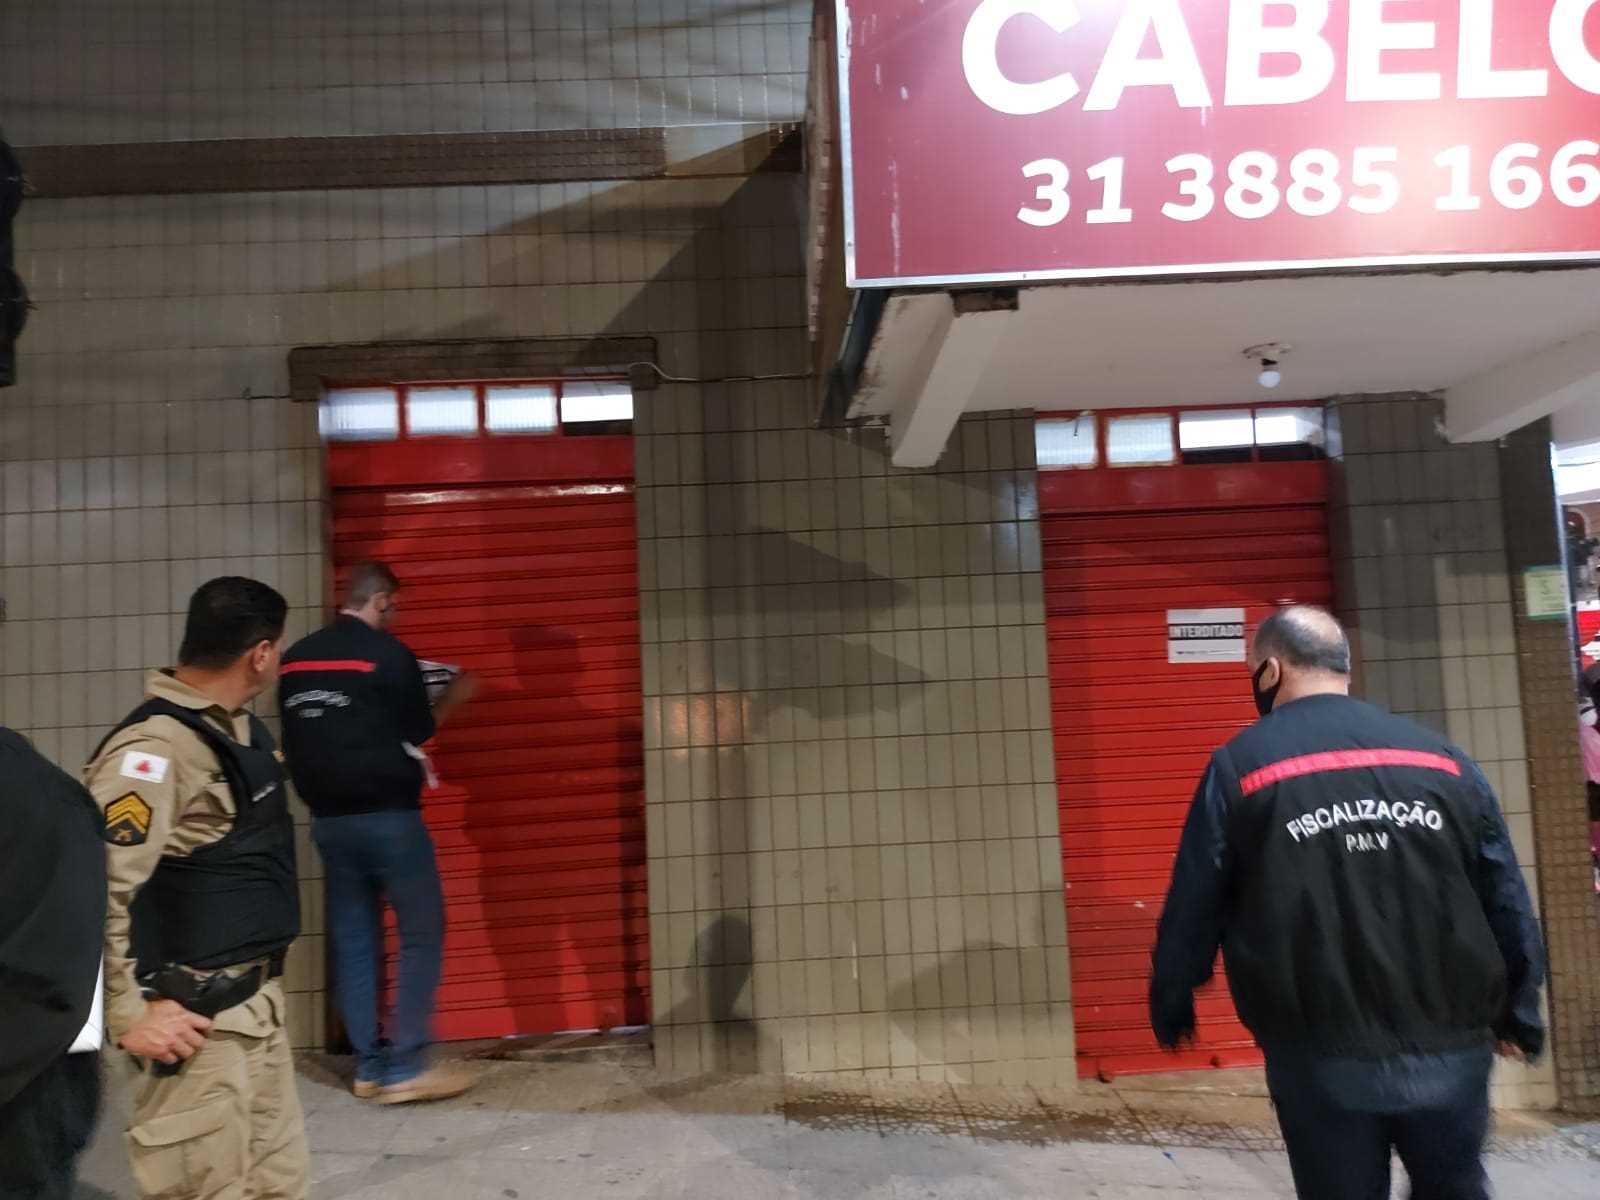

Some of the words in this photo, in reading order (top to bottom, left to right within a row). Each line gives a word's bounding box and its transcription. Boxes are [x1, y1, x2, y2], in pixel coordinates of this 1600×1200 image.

[1017, 156, 1133, 227] 31
[1162, 147, 1400, 221] 3885
[1433, 140, 1600, 211] 166
[1286, 799, 1443, 843] FISCALIZAÇÃO
